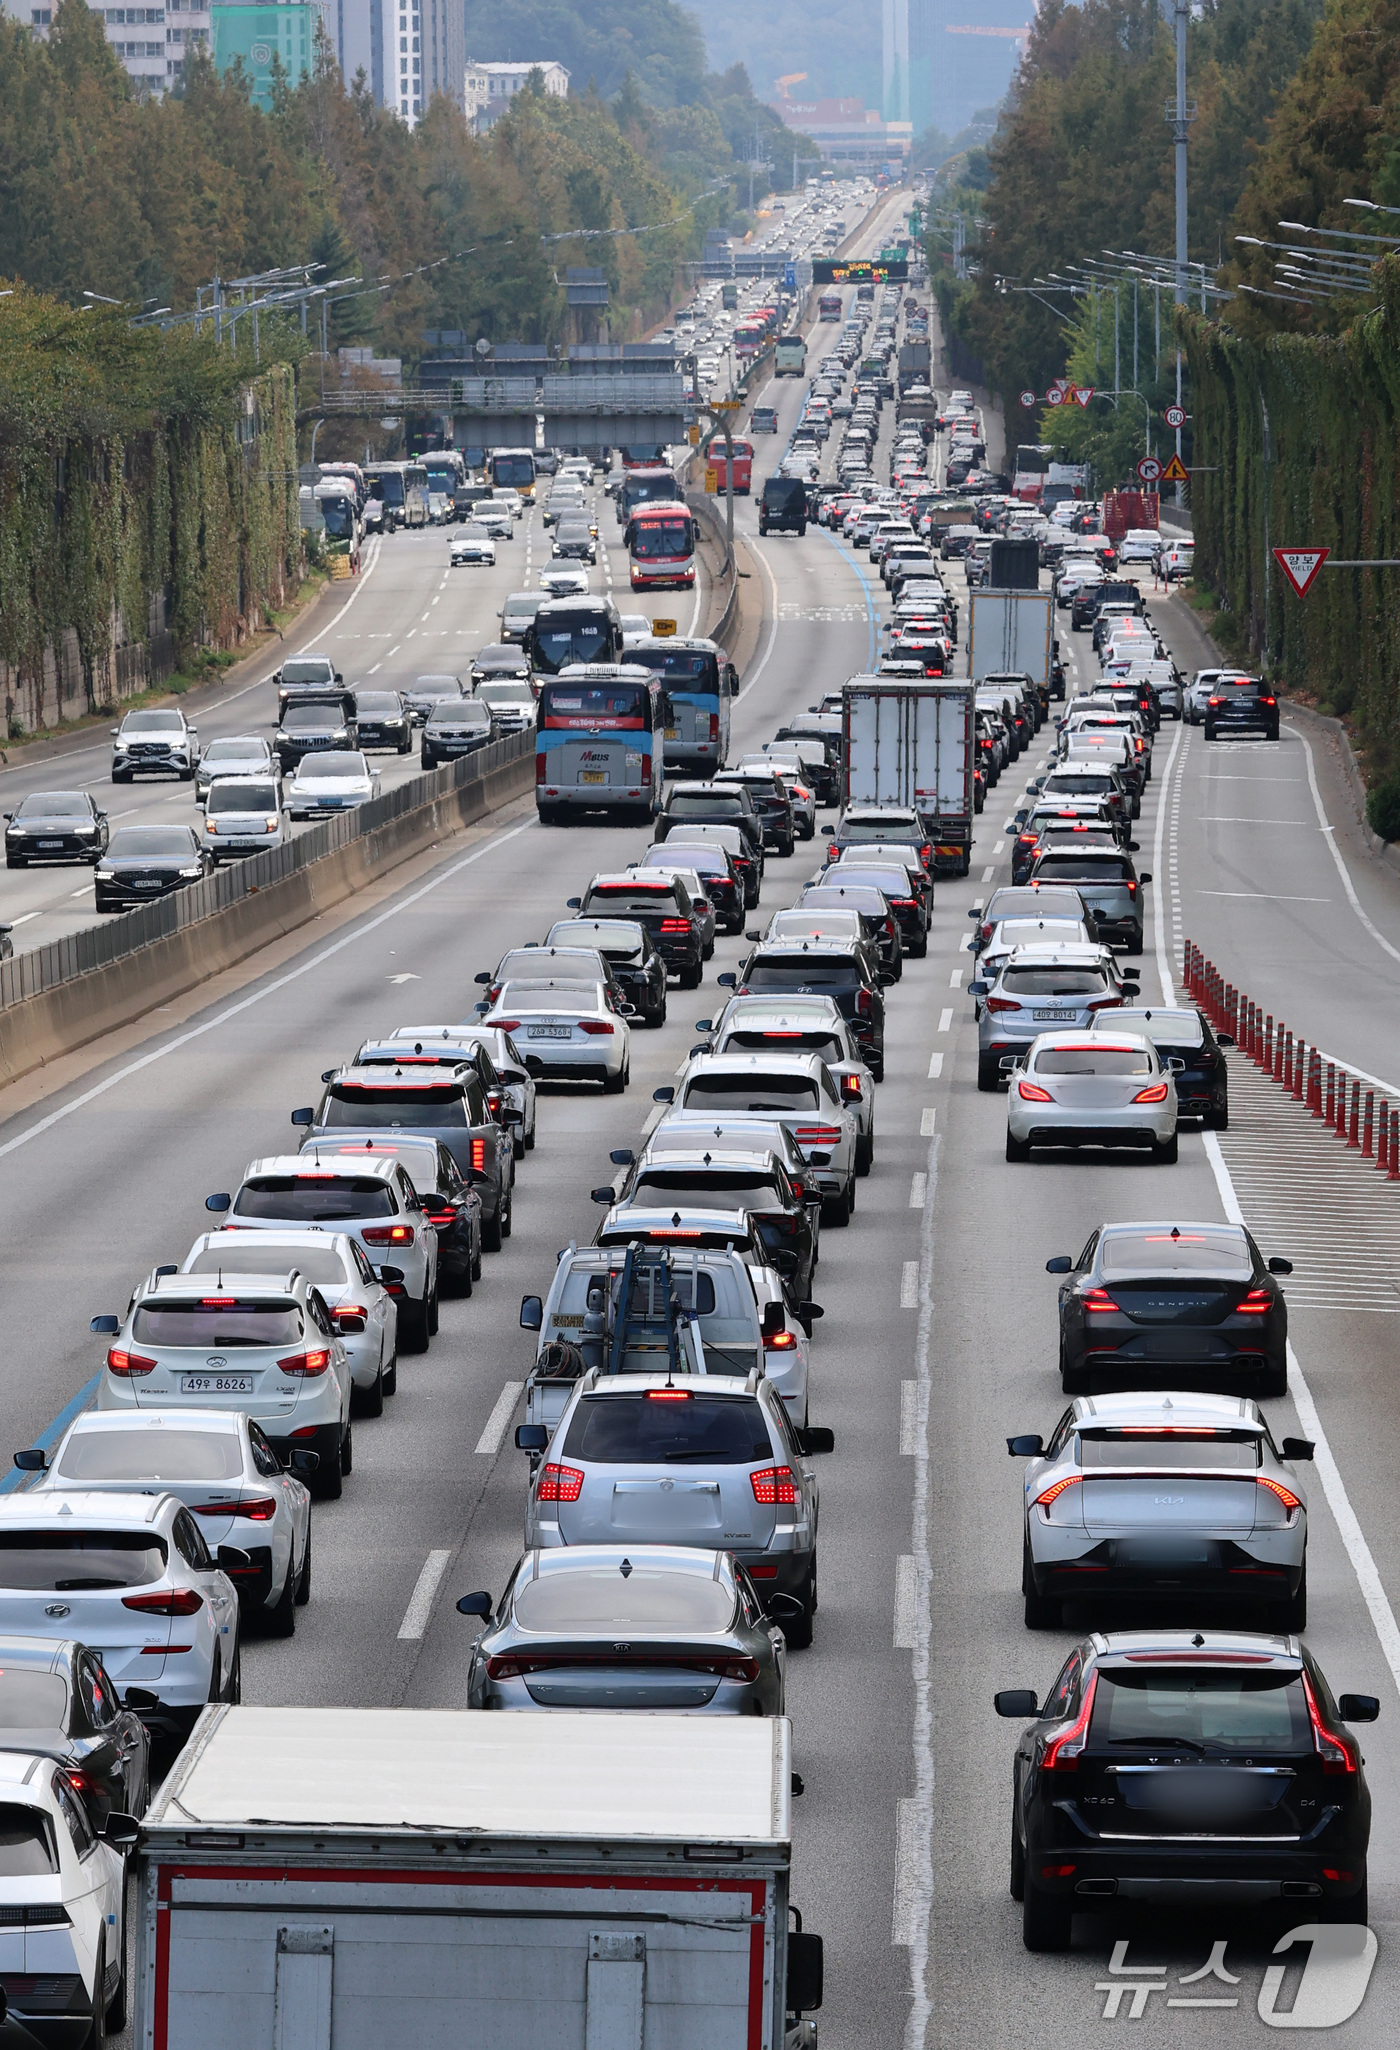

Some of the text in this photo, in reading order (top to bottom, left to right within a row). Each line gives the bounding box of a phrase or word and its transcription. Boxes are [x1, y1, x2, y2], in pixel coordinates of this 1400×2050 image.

[1169, 412, 1182, 423] 80
[1289, 555, 1314, 565] 양보
[548, 1028, 567, 1036] 5368
[187, 1379, 246, 1390] 49우 8626
[1154, 1497, 1184, 1505] KIA
[1148, 1758, 1253, 1766] VOLVO
